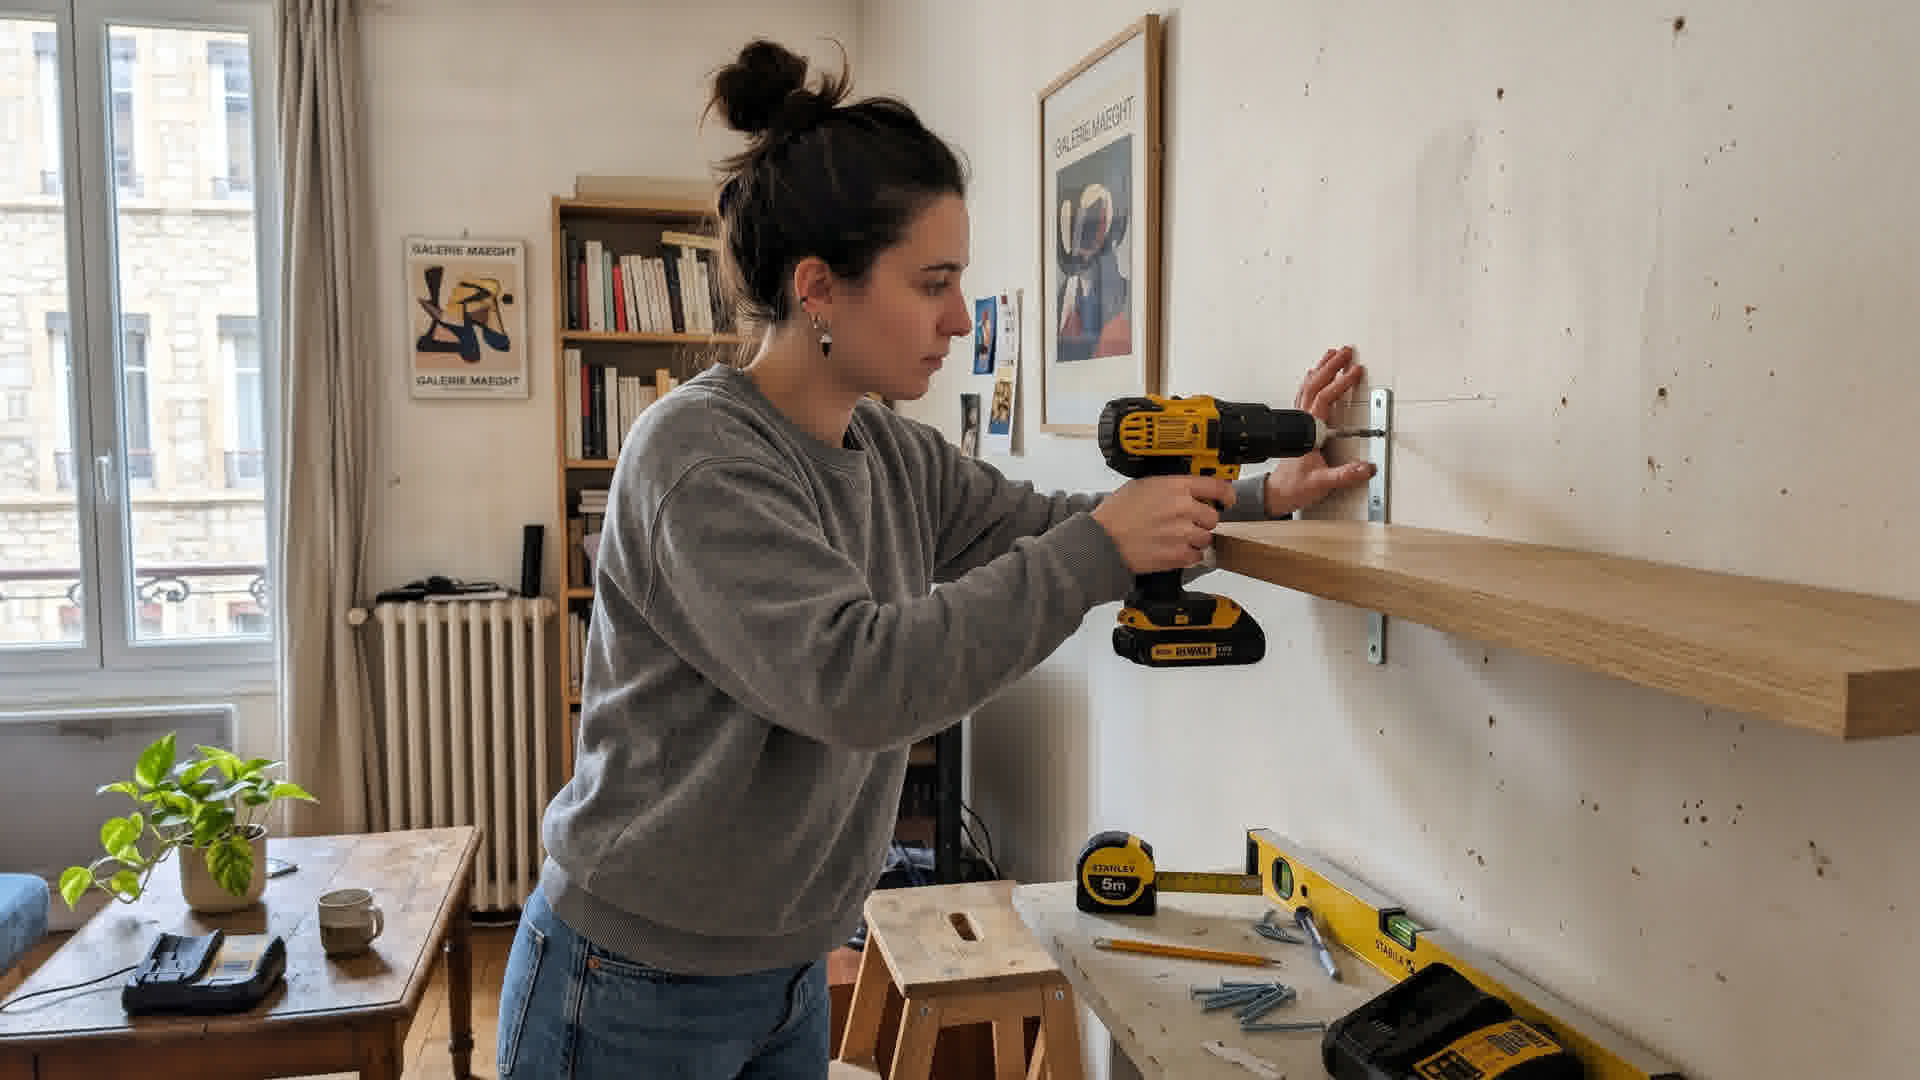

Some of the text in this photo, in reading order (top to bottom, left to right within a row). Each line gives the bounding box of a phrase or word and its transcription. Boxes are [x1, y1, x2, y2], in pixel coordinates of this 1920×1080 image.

[1092, 95, 1135, 137] MAEGHT
[411, 244, 517, 257] GALERIE MAEGHT
[416, 375, 520, 385] GALERIE MAEGHT
[1101, 877, 1126, 892] 5m
